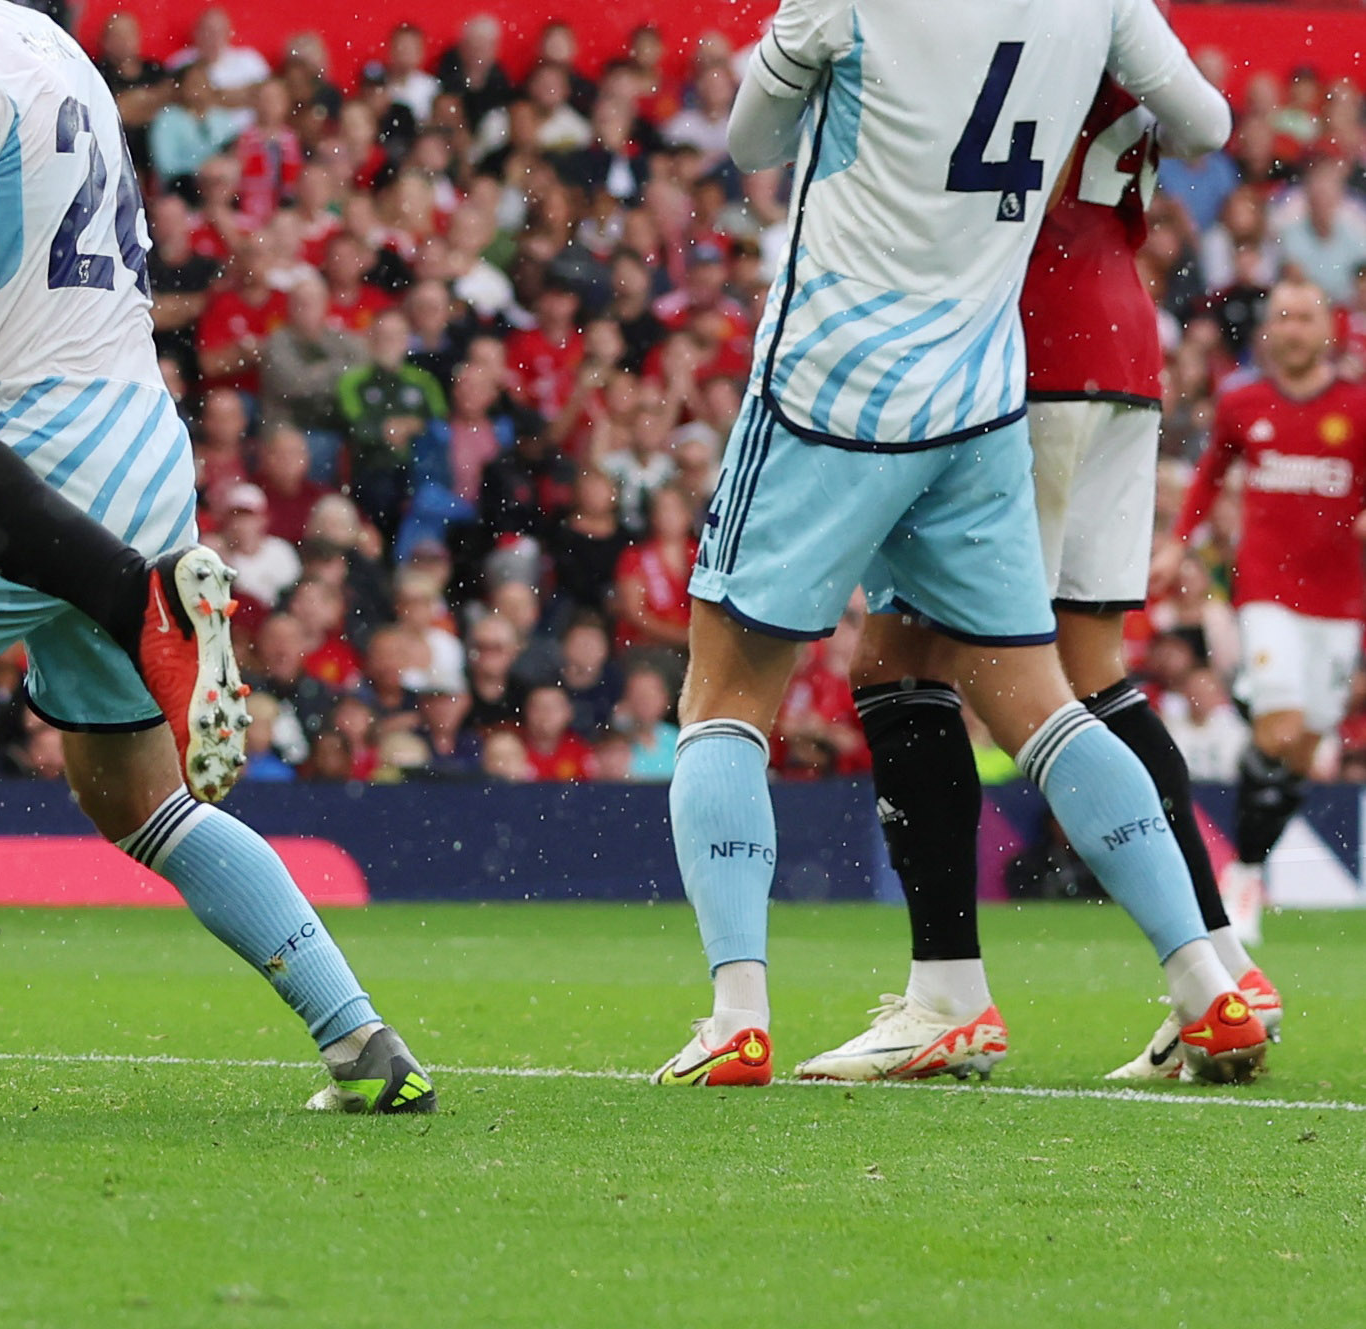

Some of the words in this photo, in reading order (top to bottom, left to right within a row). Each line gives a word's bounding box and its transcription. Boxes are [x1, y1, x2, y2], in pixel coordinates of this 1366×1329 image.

[945, 41, 1044, 222] 4
[1101, 816, 1167, 851] NFFC
[710, 841, 775, 866] NFFC
